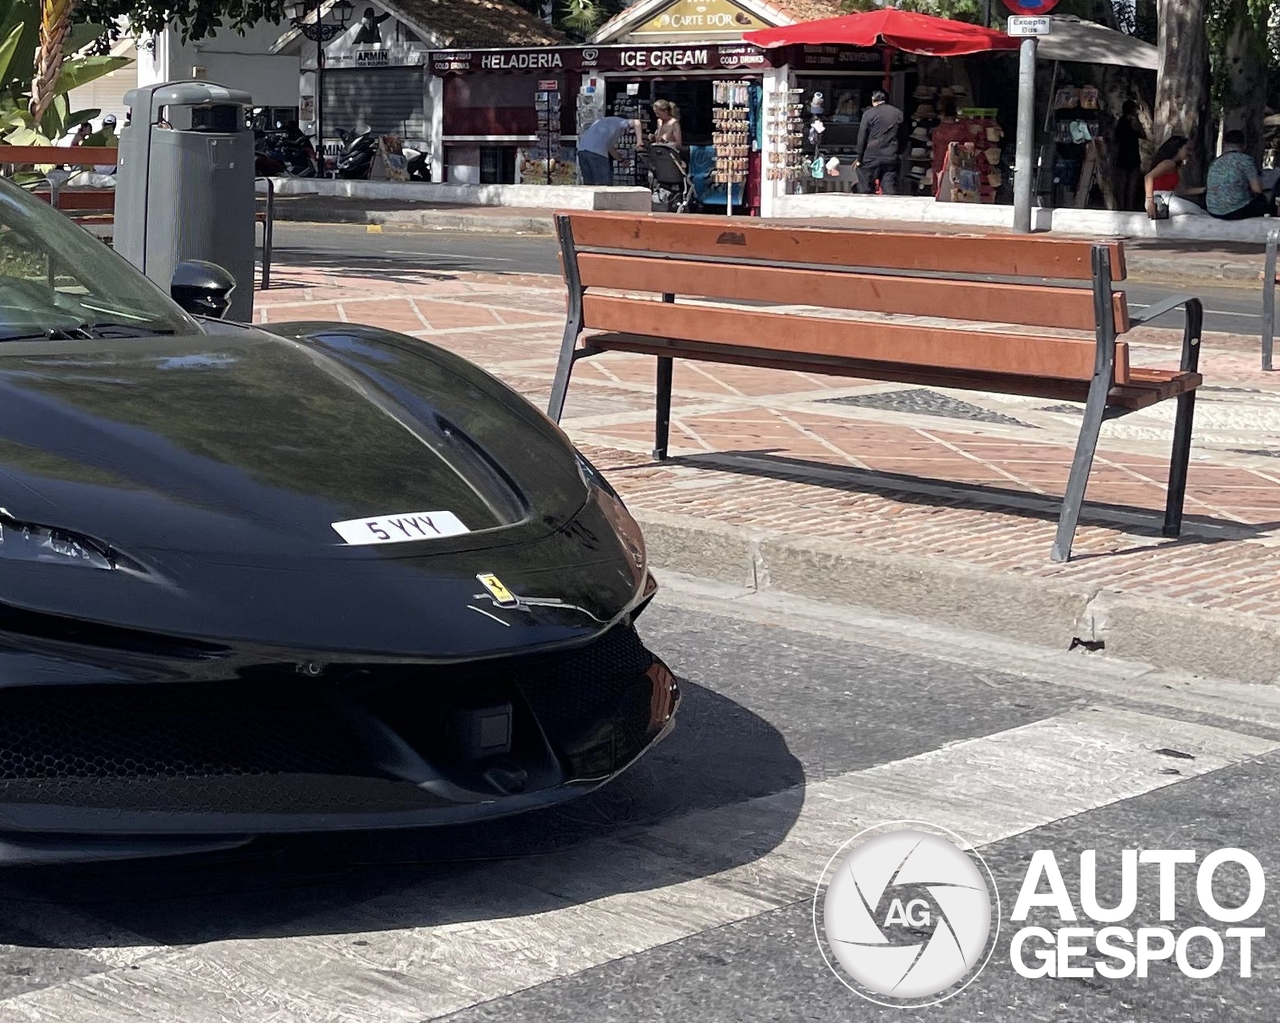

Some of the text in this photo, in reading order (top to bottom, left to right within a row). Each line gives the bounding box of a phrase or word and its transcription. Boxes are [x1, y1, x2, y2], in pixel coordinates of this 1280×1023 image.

[671, 13, 704, 27] CARTE
[1013, 18, 1046, 26] Excepto
[357, 51, 388, 61] ARMIN
[481, 53, 563, 68] HELADERIA
[620, 49, 708, 66] ICE CREAM
[720, 55, 764, 64] COLD DRINKS
[366, 516, 441, 540] 5 YYY
